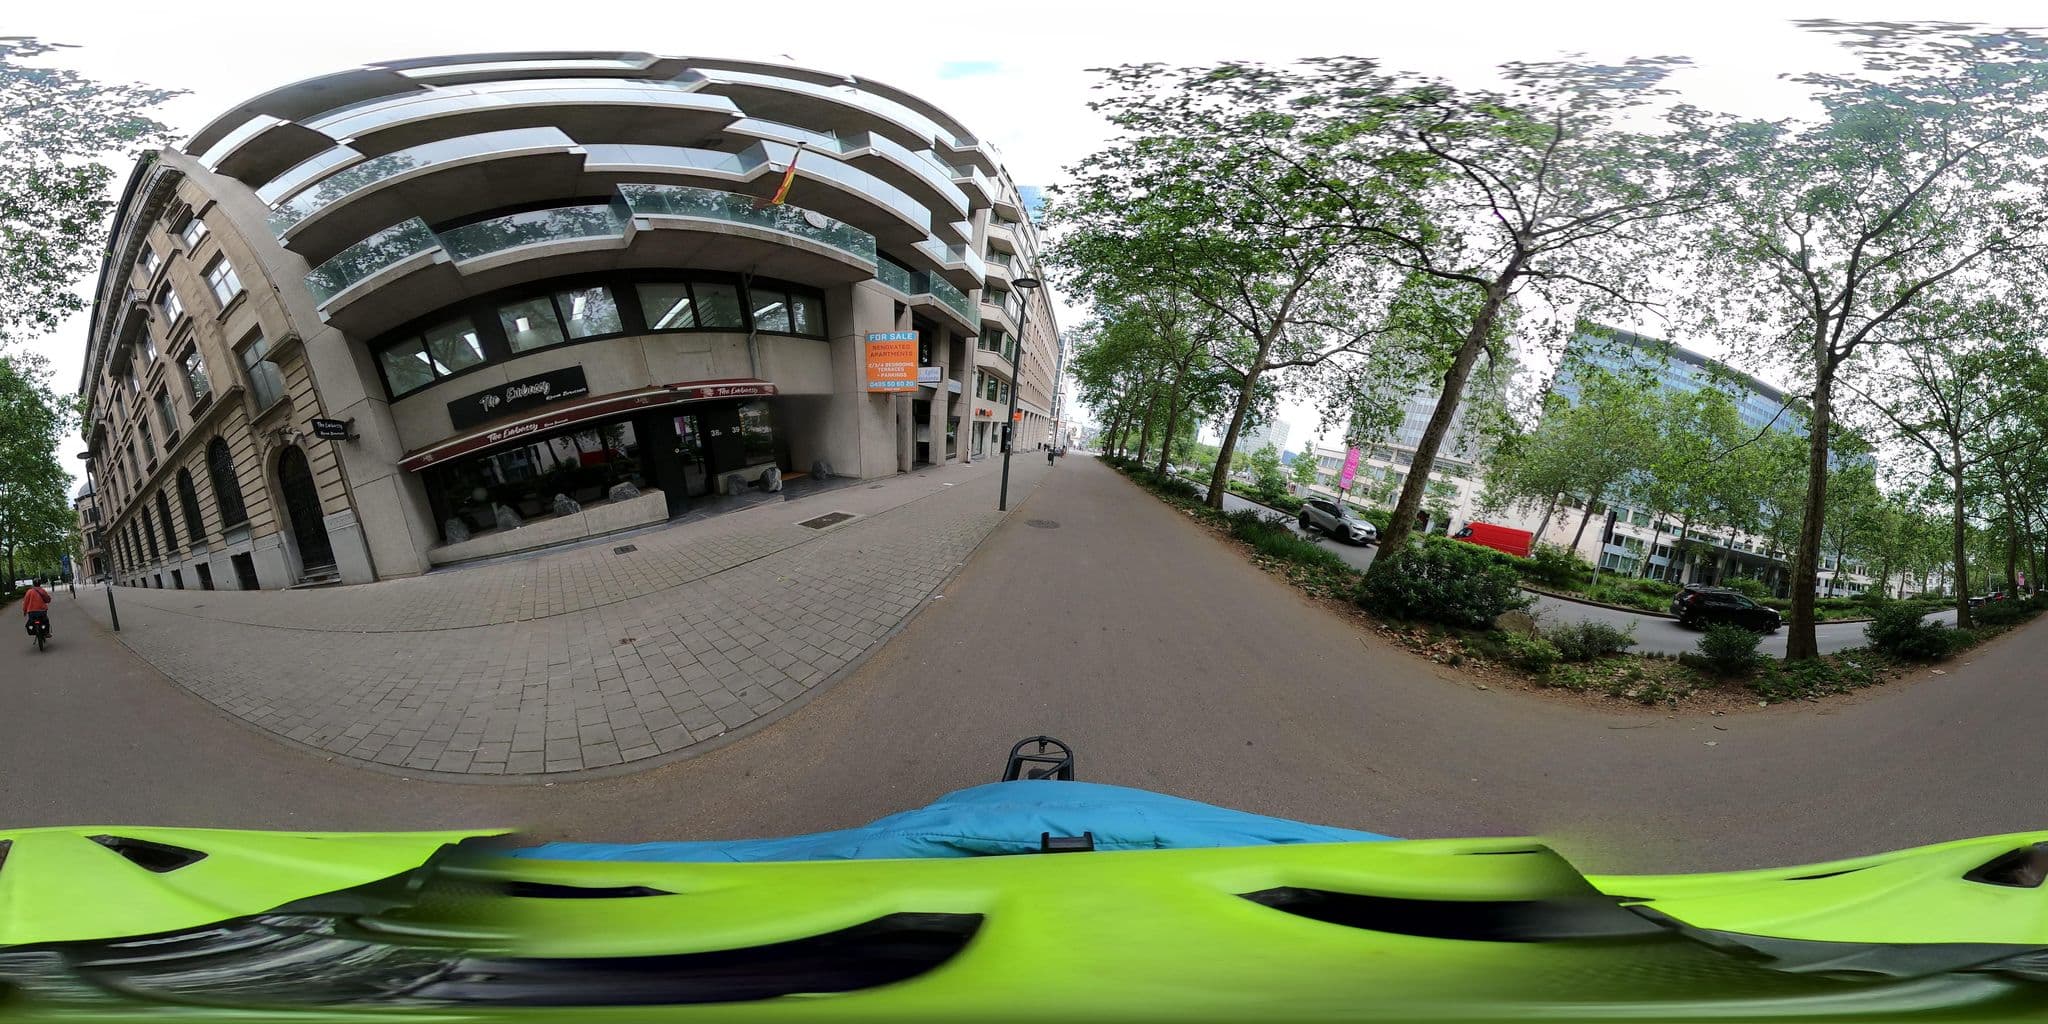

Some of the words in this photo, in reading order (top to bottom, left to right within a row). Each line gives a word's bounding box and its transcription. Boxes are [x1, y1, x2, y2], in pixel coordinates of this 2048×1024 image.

[479, 394, 501, 412] The
[505, 380, 551, 403] Embassy
[719, 387, 730, 396] The
[731, 386, 758, 395] Embassy
[486, 433, 503, 443] The
[503, 424, 538, 439] Embassy
